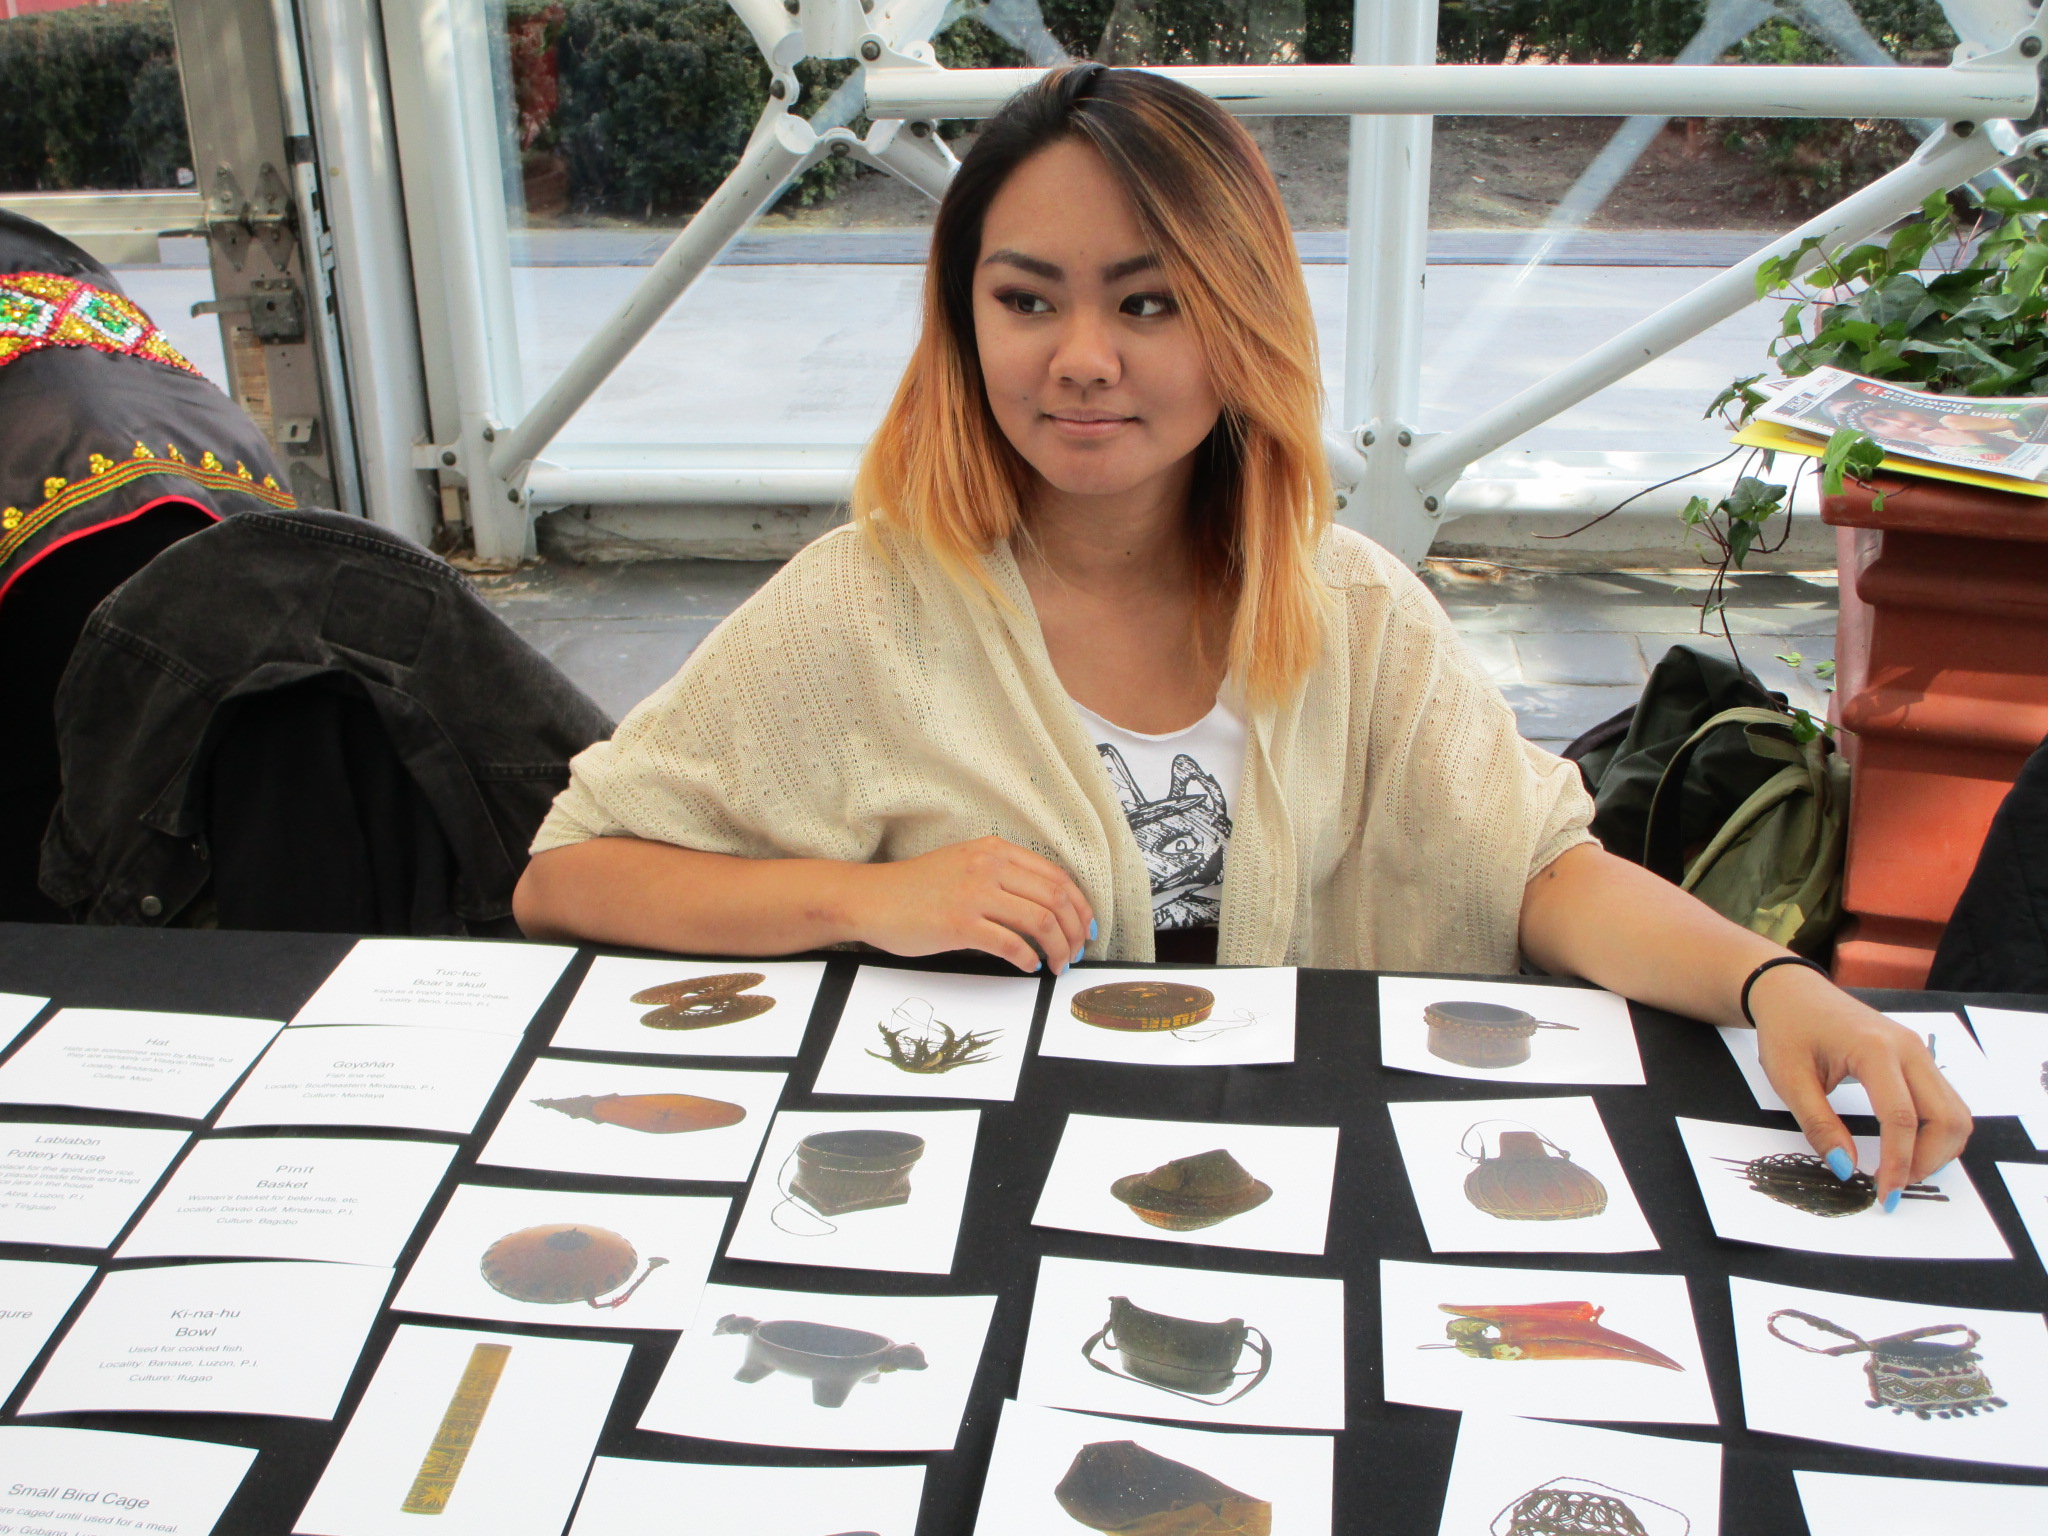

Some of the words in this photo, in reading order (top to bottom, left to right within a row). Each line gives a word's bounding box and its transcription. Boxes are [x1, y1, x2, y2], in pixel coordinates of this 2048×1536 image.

[1878, 392, 1964, 415] american
[1970, 410, 2020, 420] asian
[435, 968, 482, 977] Tuc-tuc
[412, 978, 454, 987] Boar's
[456, 981, 488, 989] skull
[146, 1038, 170, 1046] Hat
[101, 1047, 148, 1056] sometimes
[104, 1054, 140, 1062] certainly
[191, 1060, 216, 1068] make.
[368, 1083, 417, 1091] Mindanao,
[7, 1149, 59, 1160] Pottery
[61, 1151, 106, 1162] house
[60, 1166, 84, 1174] spirit
[71, 1174, 95, 1182] them
[256, 1180, 309, 1189] Basket
[15, 1202, 57, 1211] Tinguian
[281, 1207, 334, 1215] Mindanao,
[258, 1218, 298, 1226] Bagobo
[170, 1308, 241, 1319] Ki-na-hu
[175, 1327, 218, 1337] Bowl
[128, 1345, 158, 1353] Used
[99, 1360, 145, 1369] Locality:
[148, 1359, 194, 1368] Banaue,
[198, 1359, 235, 1368] Luzon,
[129, 1374, 174, 1382] Culture:
[177, 1374, 213, 1383] Ifugao
[8, 1483, 60, 1498] Small
[61, 1488, 99, 1503] Bird
[101, 1492, 150, 1510] Cage
[16, 1507, 55, 1518] caged
[56, 1510, 83, 1521] until
[83, 1514, 115, 1525] used
[115, 1517, 133, 1527] for
[134, 1521, 144, 1529] a
[145, 1522, 178, 1534] meal.
